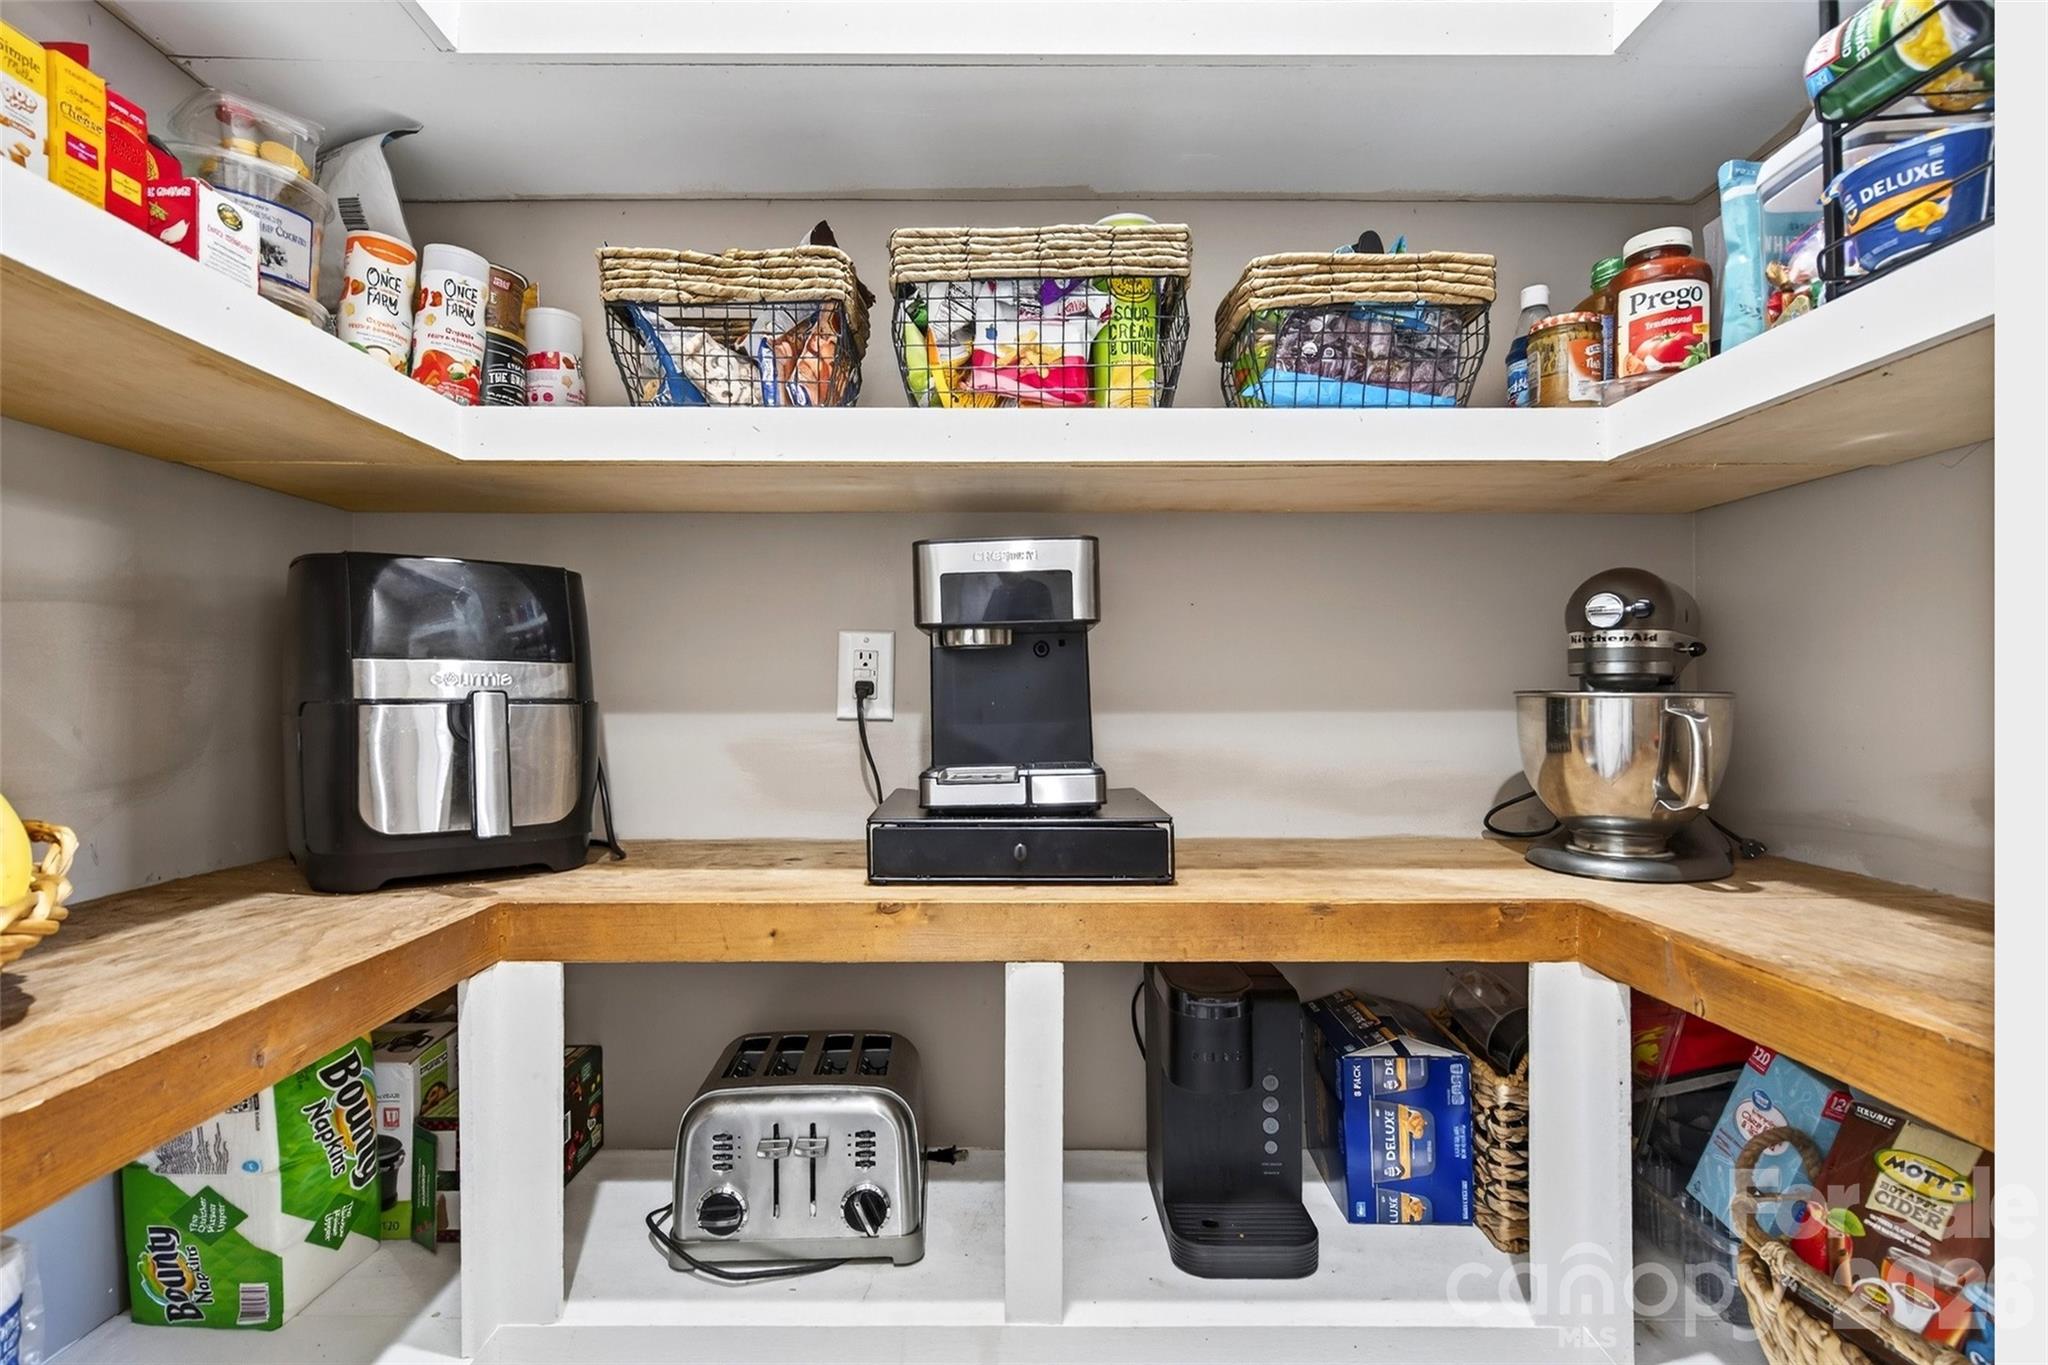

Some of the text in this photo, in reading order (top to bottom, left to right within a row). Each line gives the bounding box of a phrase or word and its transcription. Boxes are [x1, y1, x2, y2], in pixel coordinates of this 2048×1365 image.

[1859, 159, 1945, 204] DELUXE
[366, 267, 402, 294] ONCE
[444, 278, 479, 305] ONCE
[366, 287, 399, 316] FARM
[445, 298, 476, 327] FARM
[1114, 305, 1149, 322] SOUR
[1629, 286, 1704, 316] Prego
[1108, 322, 1154, 340] CREAM
[1570, 632, 1658, 644] KitchenAid
[317, 1048, 378, 1190] Bounty
[301, 1097, 347, 1179] Napkins
[1384, 1110, 1397, 1161] DELUXE
[1874, 1190, 1943, 1231] CIDER
[147, 1225, 206, 1324] Bounty
[186, 1245, 214, 1305] Napkins
